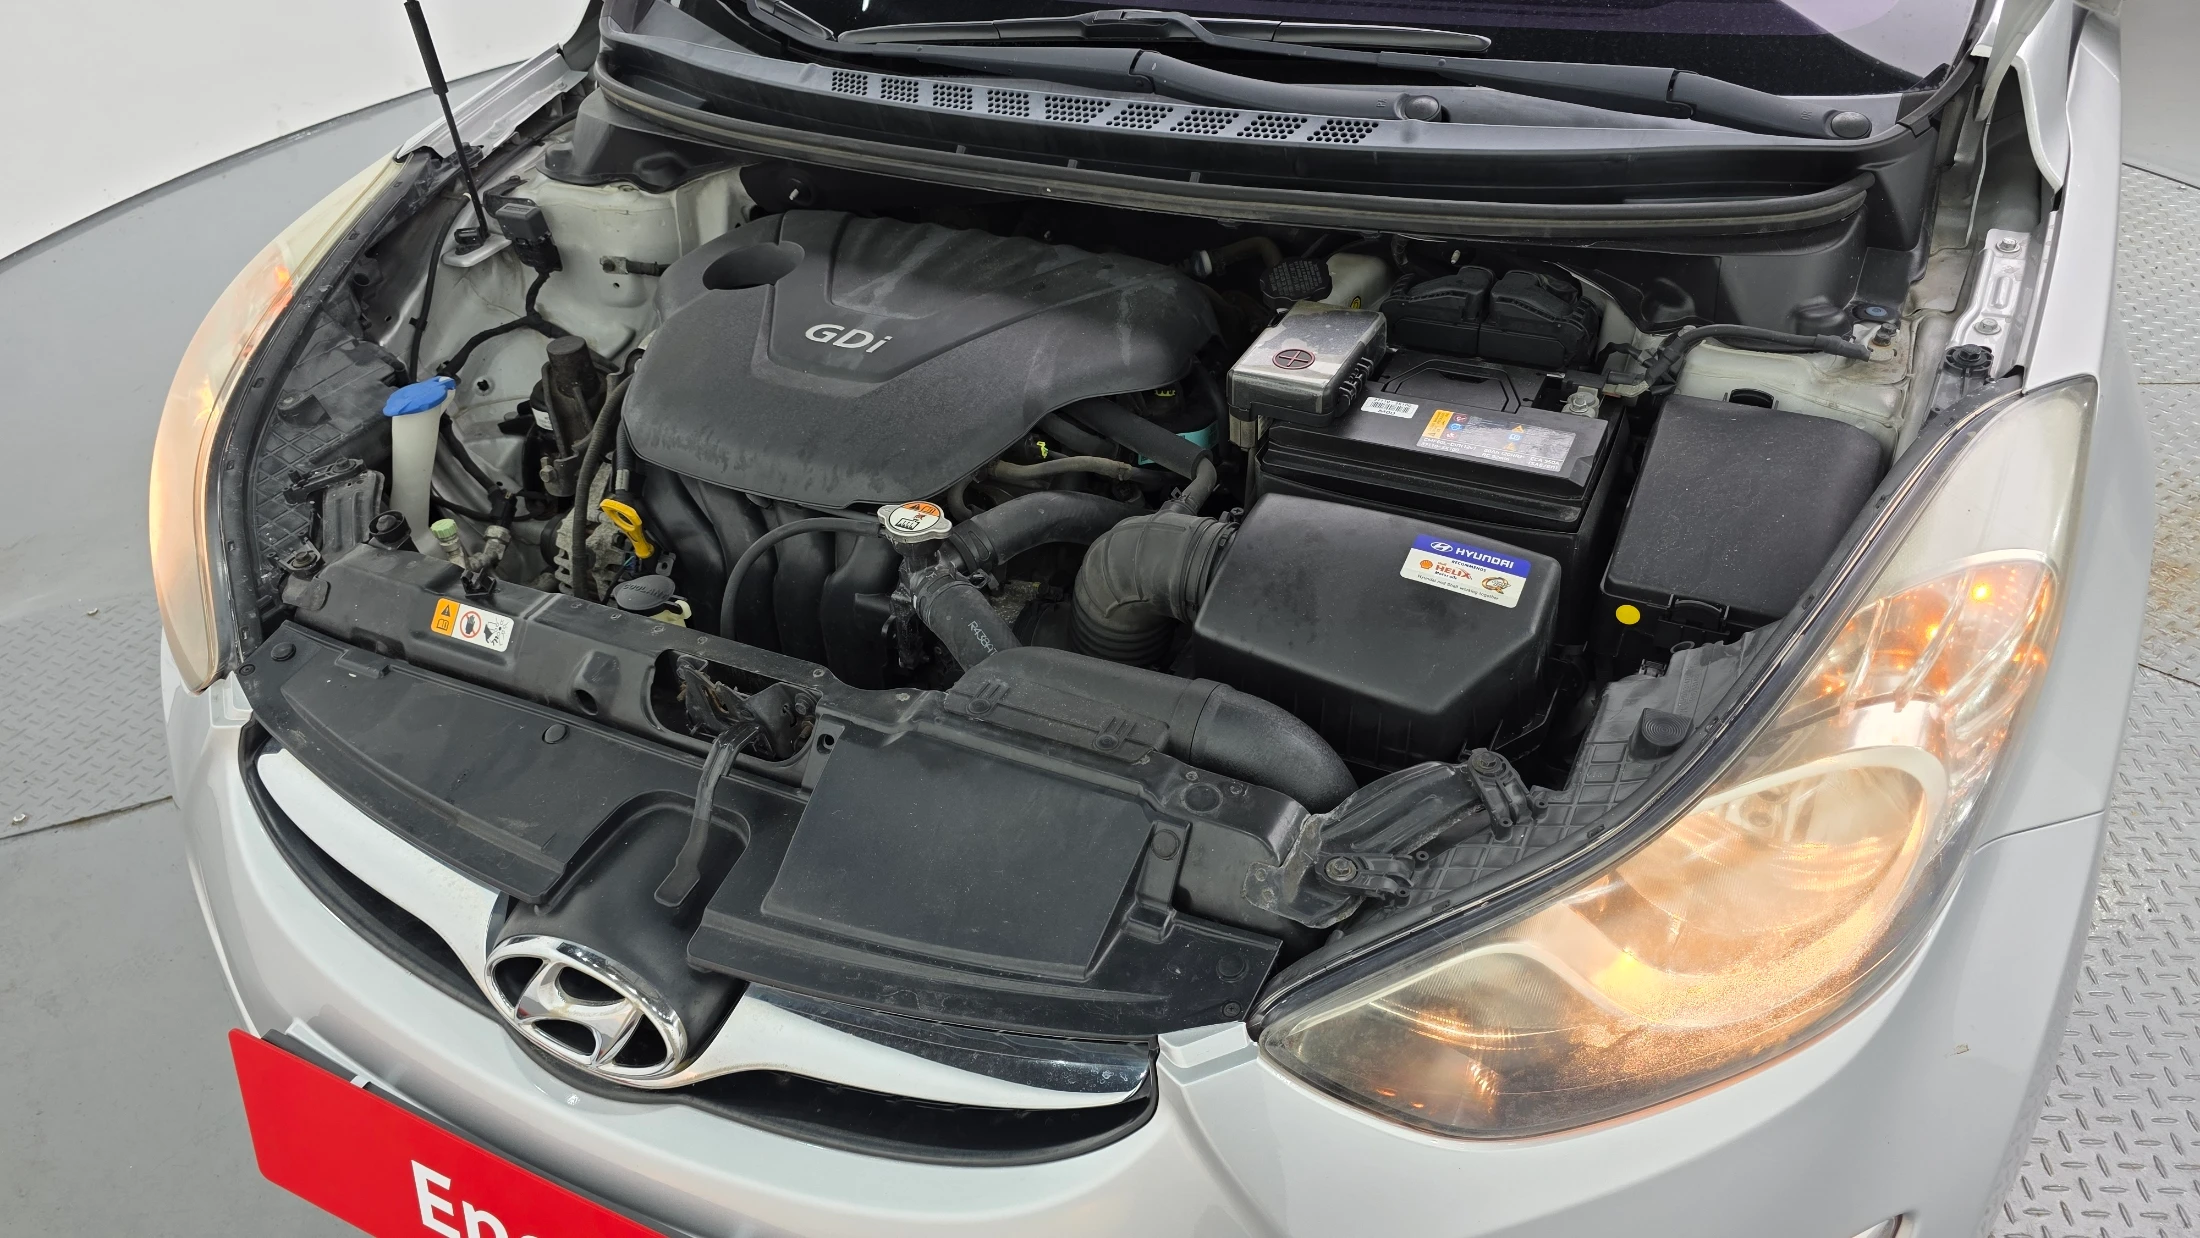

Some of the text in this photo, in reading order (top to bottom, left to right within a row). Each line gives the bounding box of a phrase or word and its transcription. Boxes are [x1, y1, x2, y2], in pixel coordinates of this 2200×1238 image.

[805, 323, 893, 353] GDi
[1455, 547, 1514, 569] HYUNDAI
[1435, 564, 1472, 580] HELIX
[411, 1159, 539, 1238] En
